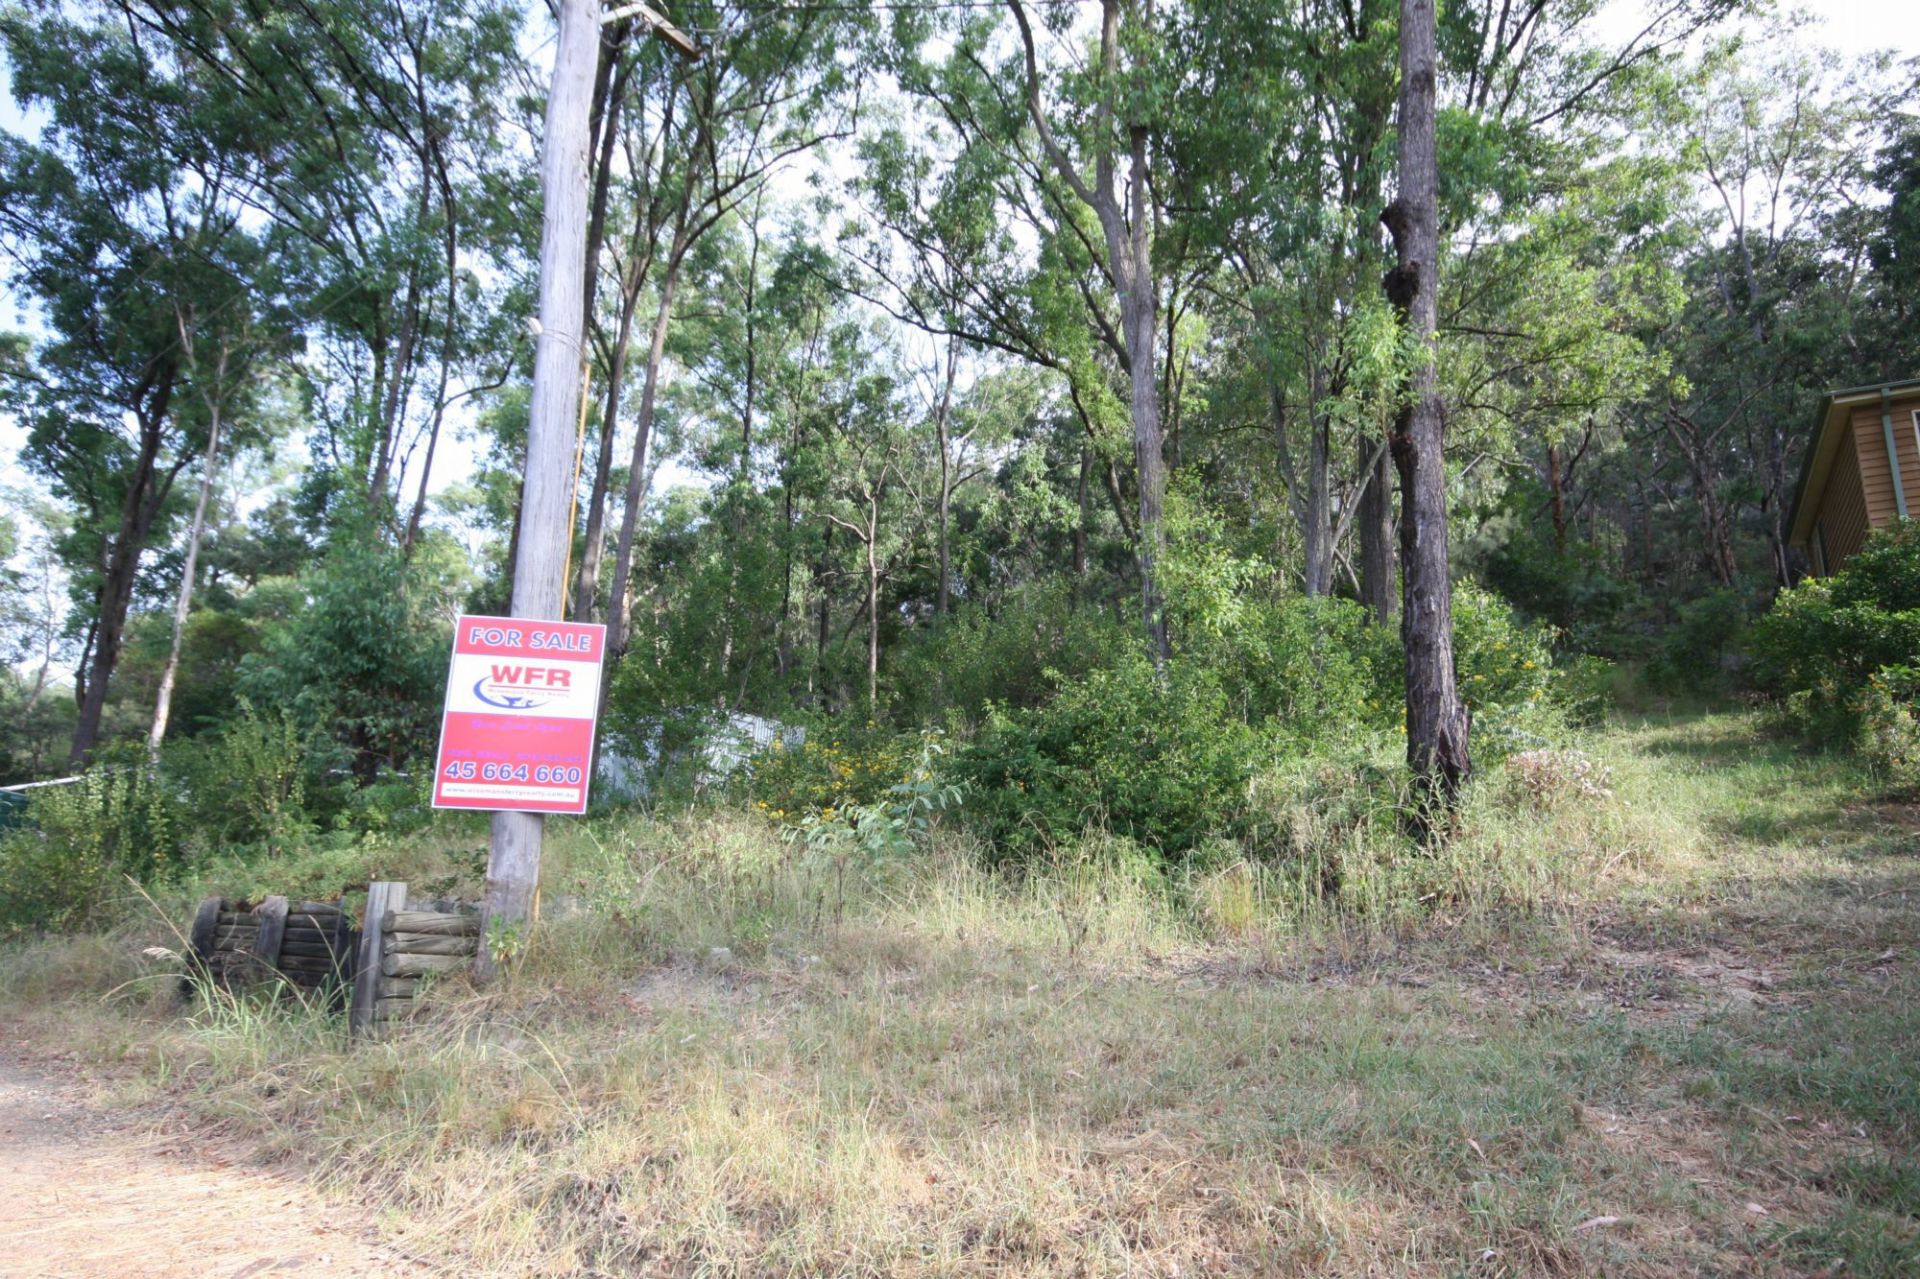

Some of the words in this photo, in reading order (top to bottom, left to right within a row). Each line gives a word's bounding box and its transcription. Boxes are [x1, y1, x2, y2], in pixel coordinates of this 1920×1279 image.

[469, 627, 523, 648] FOR
[529, 631, 592, 652] SALE
[491, 664, 572, 687] WFR
[445, 760, 477, 780] 45
[482, 762, 528, 783] 664
[535, 765, 581, 784] 660
